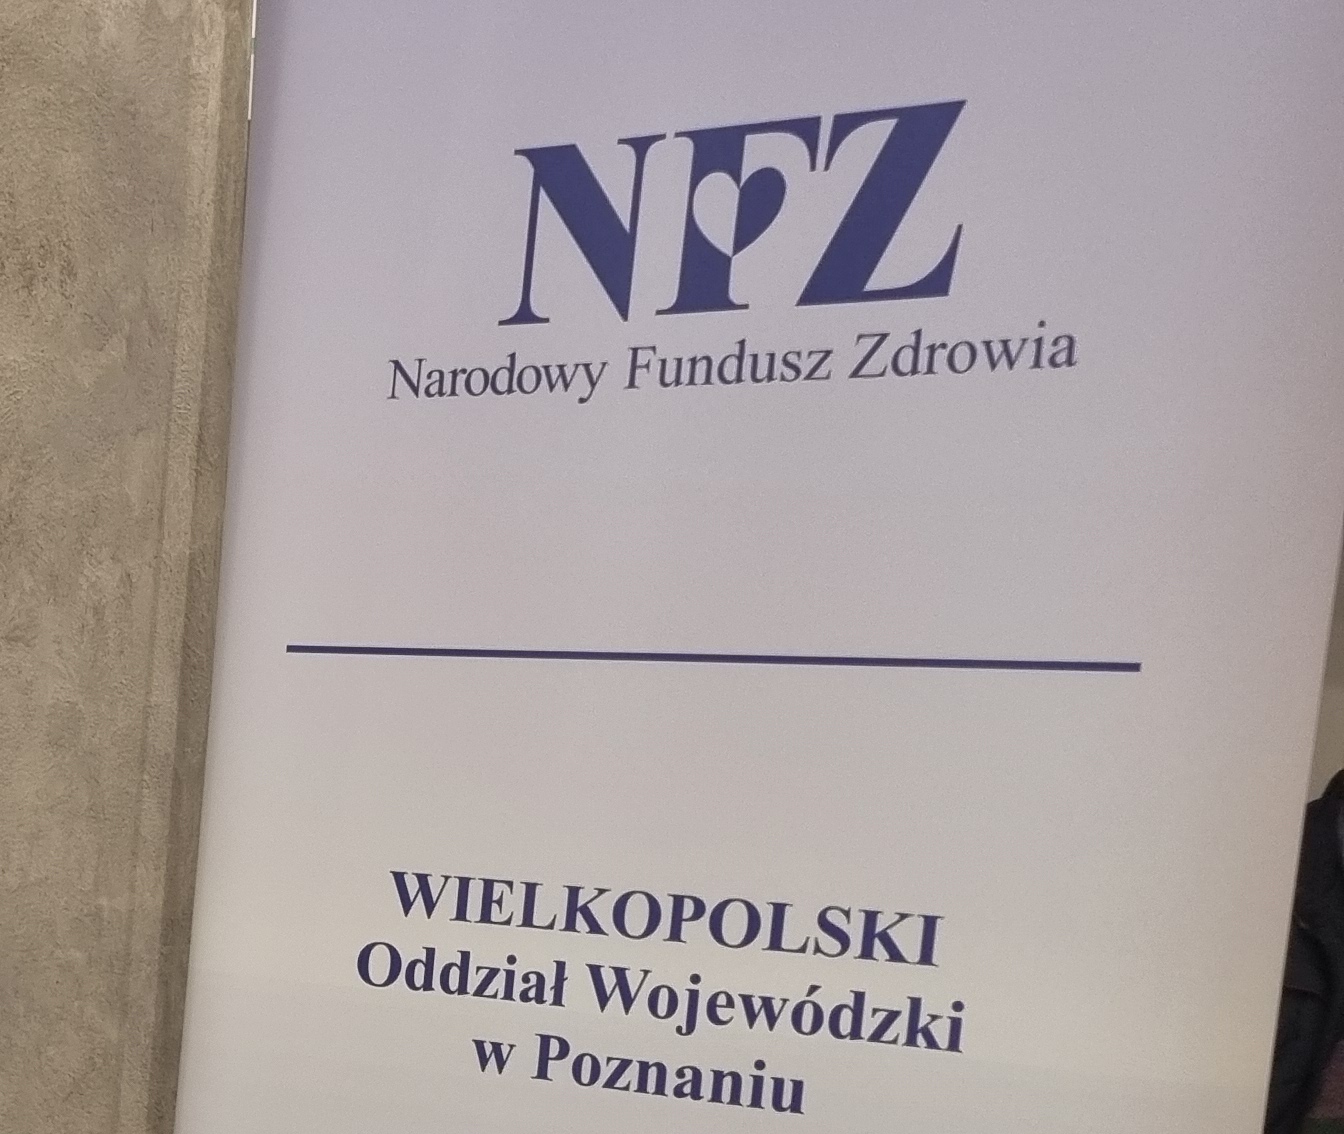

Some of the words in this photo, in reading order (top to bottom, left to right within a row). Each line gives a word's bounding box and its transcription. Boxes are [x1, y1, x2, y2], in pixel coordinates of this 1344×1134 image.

[498, 99, 967, 325] NFZ
[386, 352, 607, 404] Narodowy
[624, 340, 832, 390] Fundusz
[848, 320, 1077, 380] Zdrowia
[390, 870, 945, 968] WIELKOPOLSKI
[356, 940, 568, 1008] Oddział
[585, 963, 965, 1054] Wojewódzki
[472, 1039, 516, 1075] w
[530, 1032, 806, 1115] Poznaniu
